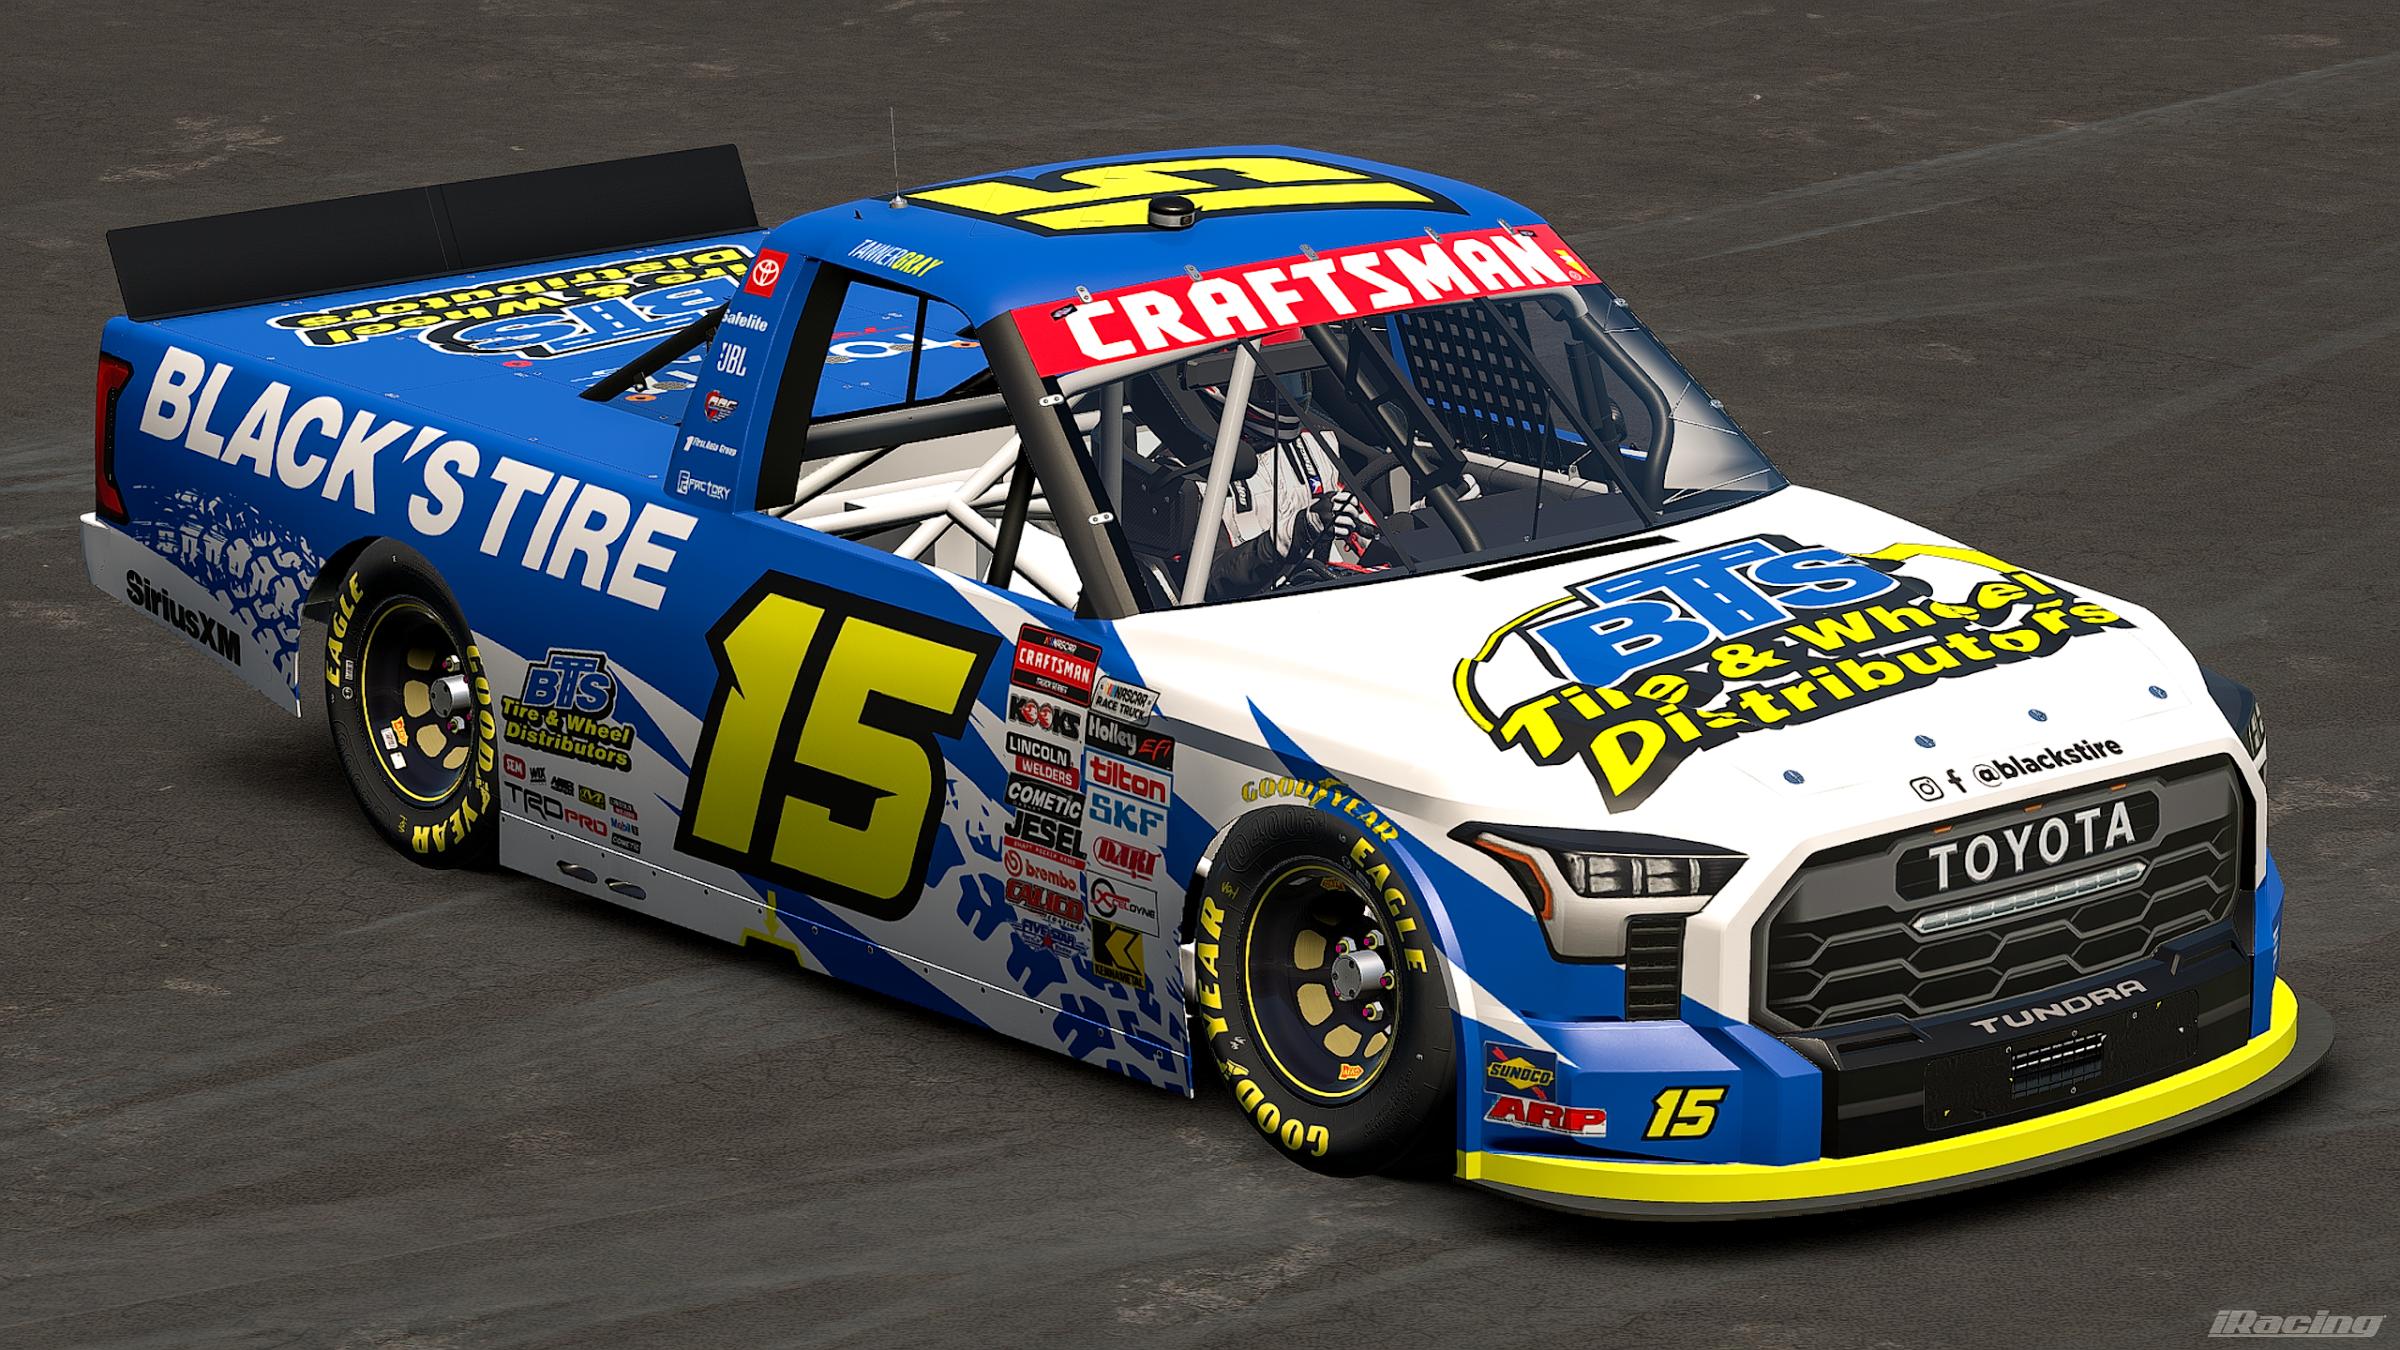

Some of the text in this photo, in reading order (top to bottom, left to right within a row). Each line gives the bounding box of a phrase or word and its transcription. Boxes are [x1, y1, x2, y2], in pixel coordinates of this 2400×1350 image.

[297, 248, 744, 329] Distributors
[654, 264, 750, 285] ire
[1065, 234, 1570, 361] CRAFTSMAN
[327, 297, 573, 344] Wheel
[722, 308, 769, 333] Safelite
[717, 342, 748, 377] JBL
[139, 346, 698, 611] BLACK'S TIRE
[126, 569, 241, 667] SiriusXM
[326, 571, 363, 688] EAGLE
[1534, 535, 1899, 688] BTS
[523, 655, 611, 711] BTS
[1018, 647, 1091, 684] CRAFTSMAN
[1500, 571, 2057, 760] Tire & Wheel
[1095, 695, 1146, 720] RACE TRUCK
[1115, 684, 1149, 708] NASCAR
[1590, 598, 2121, 797] Distributors
[503, 698, 630, 744] Tire & Wheel
[506, 720, 628, 767] Distributors
[1088, 714, 1137, 757] Holley
[692, 592, 978, 901] 15
[1009, 734, 1068, 767] LINCOLN
[1972, 735, 2124, 789] @blackstire
[1021, 759, 1073, 786] WELDERS
[1090, 755, 1166, 803] tilton
[564, 808, 608, 837] PRO
[1008, 782, 1082, 820] COMETIC
[1089, 792, 1164, 836] SKF
[1241, 776, 1400, 844] GOODYEAR
[1004, 808, 1087, 860] JESEL
[1926, 802, 2137, 889] TOYOTA
[1025, 859, 1078, 892] brembo
[1005, 877, 1085, 925] CALICO
[1350, 836, 1428, 976] EAGLE
[1094, 964, 1145, 989] KENNAMETAL
[1970, 979, 2148, 1036] TUNDRA
[1488, 1060, 1555, 1085] SUNOCO
[1489, 1096, 1605, 1132] ARP
[1646, 1087, 1727, 1139] 15
